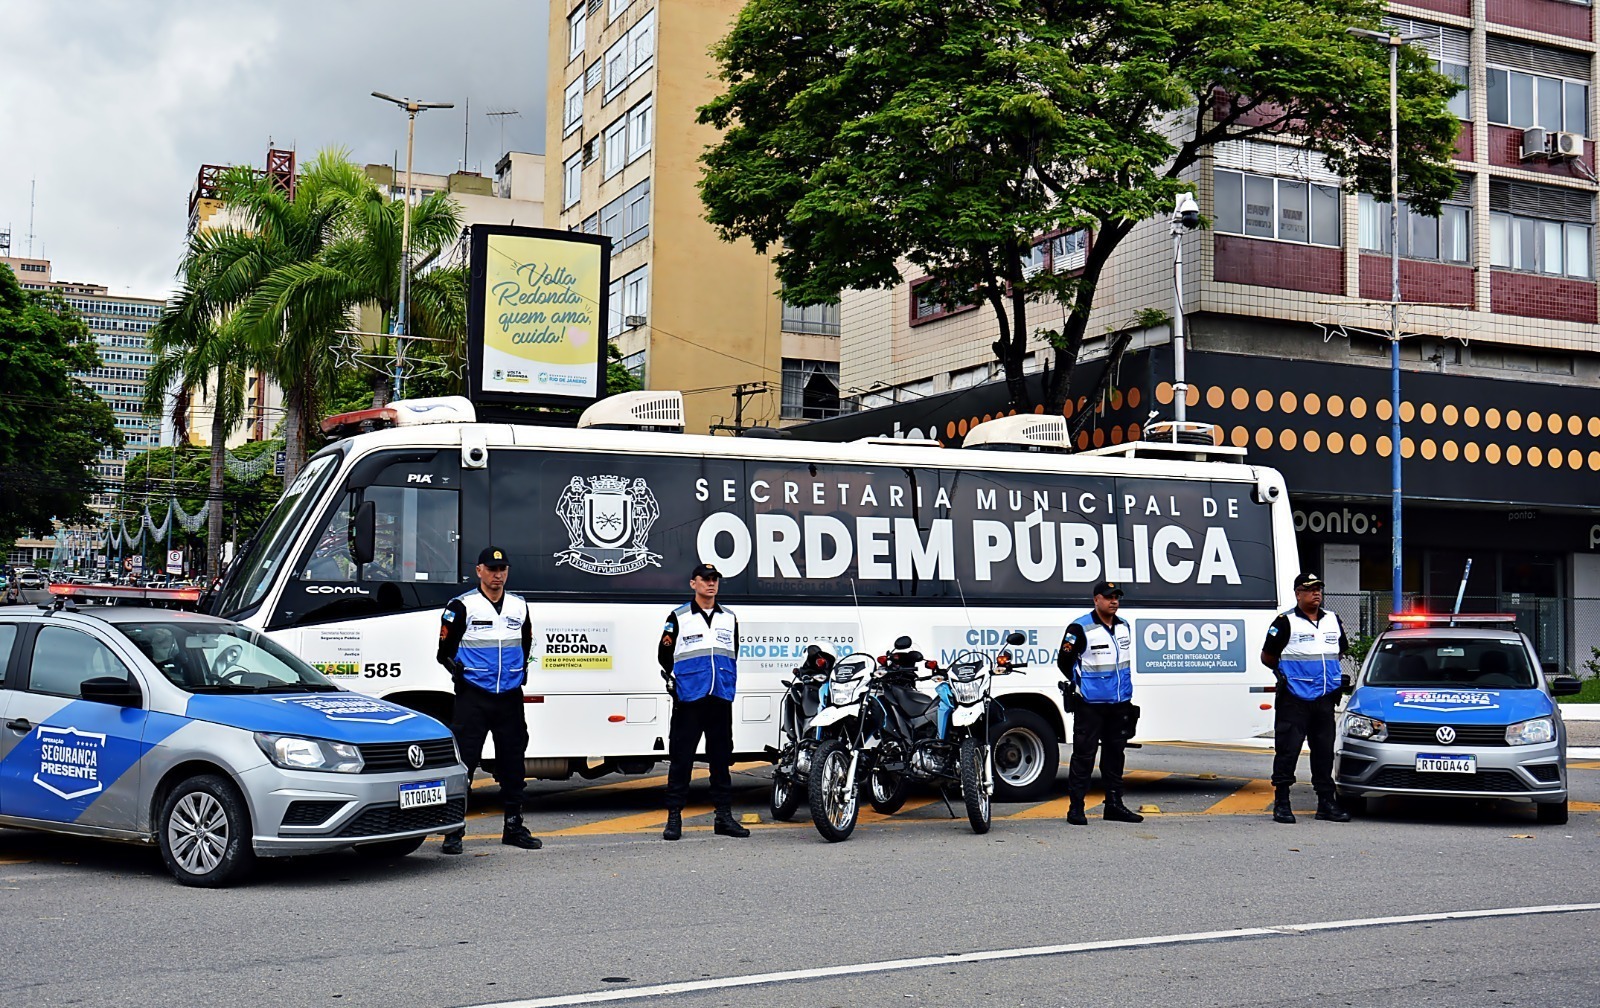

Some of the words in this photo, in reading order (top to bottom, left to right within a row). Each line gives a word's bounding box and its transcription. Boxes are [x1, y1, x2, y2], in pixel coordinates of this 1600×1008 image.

[1246, 203, 1270, 217] EASY
[516, 262, 577, 287] Volta
[498, 311, 547, 333] quem
[550, 311, 592, 326] ama,
[511, 325, 566, 345] cuida!
[695, 478, 952, 509] SECRETARIA
[976, 488, 1181, 516] MUNICIPAL
[1203, 497, 1239, 519] DE
[696, 511, 955, 581] ORDEM
[972, 507, 1242, 585] PÚBLICA
[305, 585, 370, 594] COMIL
[545, 633, 589, 644] VOLTA
[1143, 622, 1239, 651] CIOSP
[545, 644, 608, 654] REDONDA
[739, 645, 767, 658] RIO
[769, 645, 789, 658] DE
[311, 664, 359, 676] RASIL
[363, 662, 402, 679] 585
[1145, 660, 1177, 669] OPERAÇÕES
[1177, 660, 1184, 668] DE
[1184, 660, 1216, 669] SEGURANÇA
[1216, 659, 1238, 667] PÚBLICA
[41, 744, 98, 768] SEGURANÇA
[41, 761, 97, 780] PRESENTE
